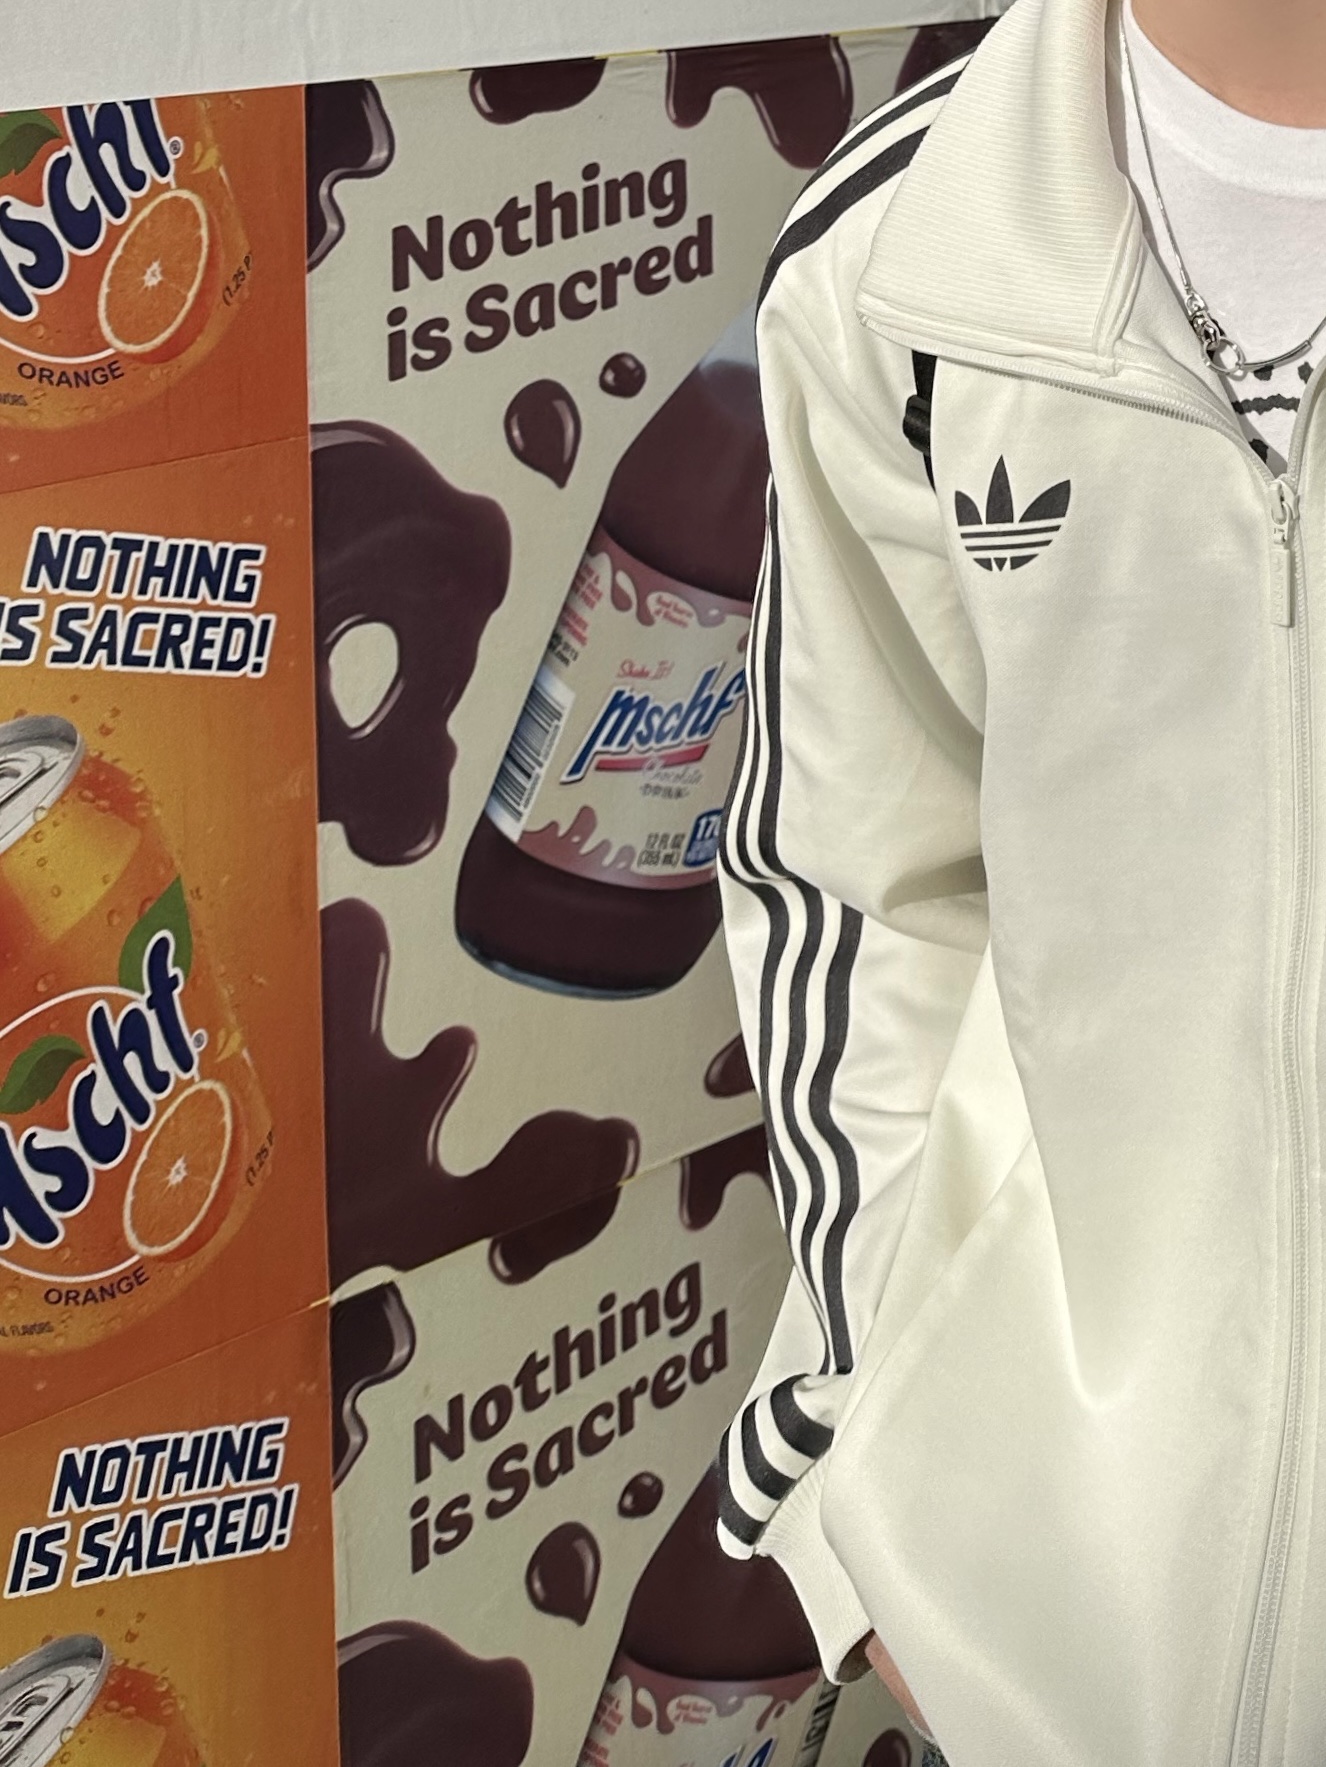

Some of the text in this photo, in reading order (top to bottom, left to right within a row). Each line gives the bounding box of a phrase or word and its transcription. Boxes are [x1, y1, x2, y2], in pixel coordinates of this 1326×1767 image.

[392, 159, 688, 292] Nothing
[387, 214, 714, 381] is Sacred
[18, 361, 124, 388] ORANGE
[26, 530, 263, 604] NOTHING
[50, 607, 272, 673] SACRED!
[44, 1265, 150, 1306] ORANGE
[414, 1261, 701, 1484] Nothing
[52, 1422, 286, 1513] NOTHING
[410, 1308, 727, 1574] is Sacred
[7, 1488, 295, 1594] IS SACRED!
